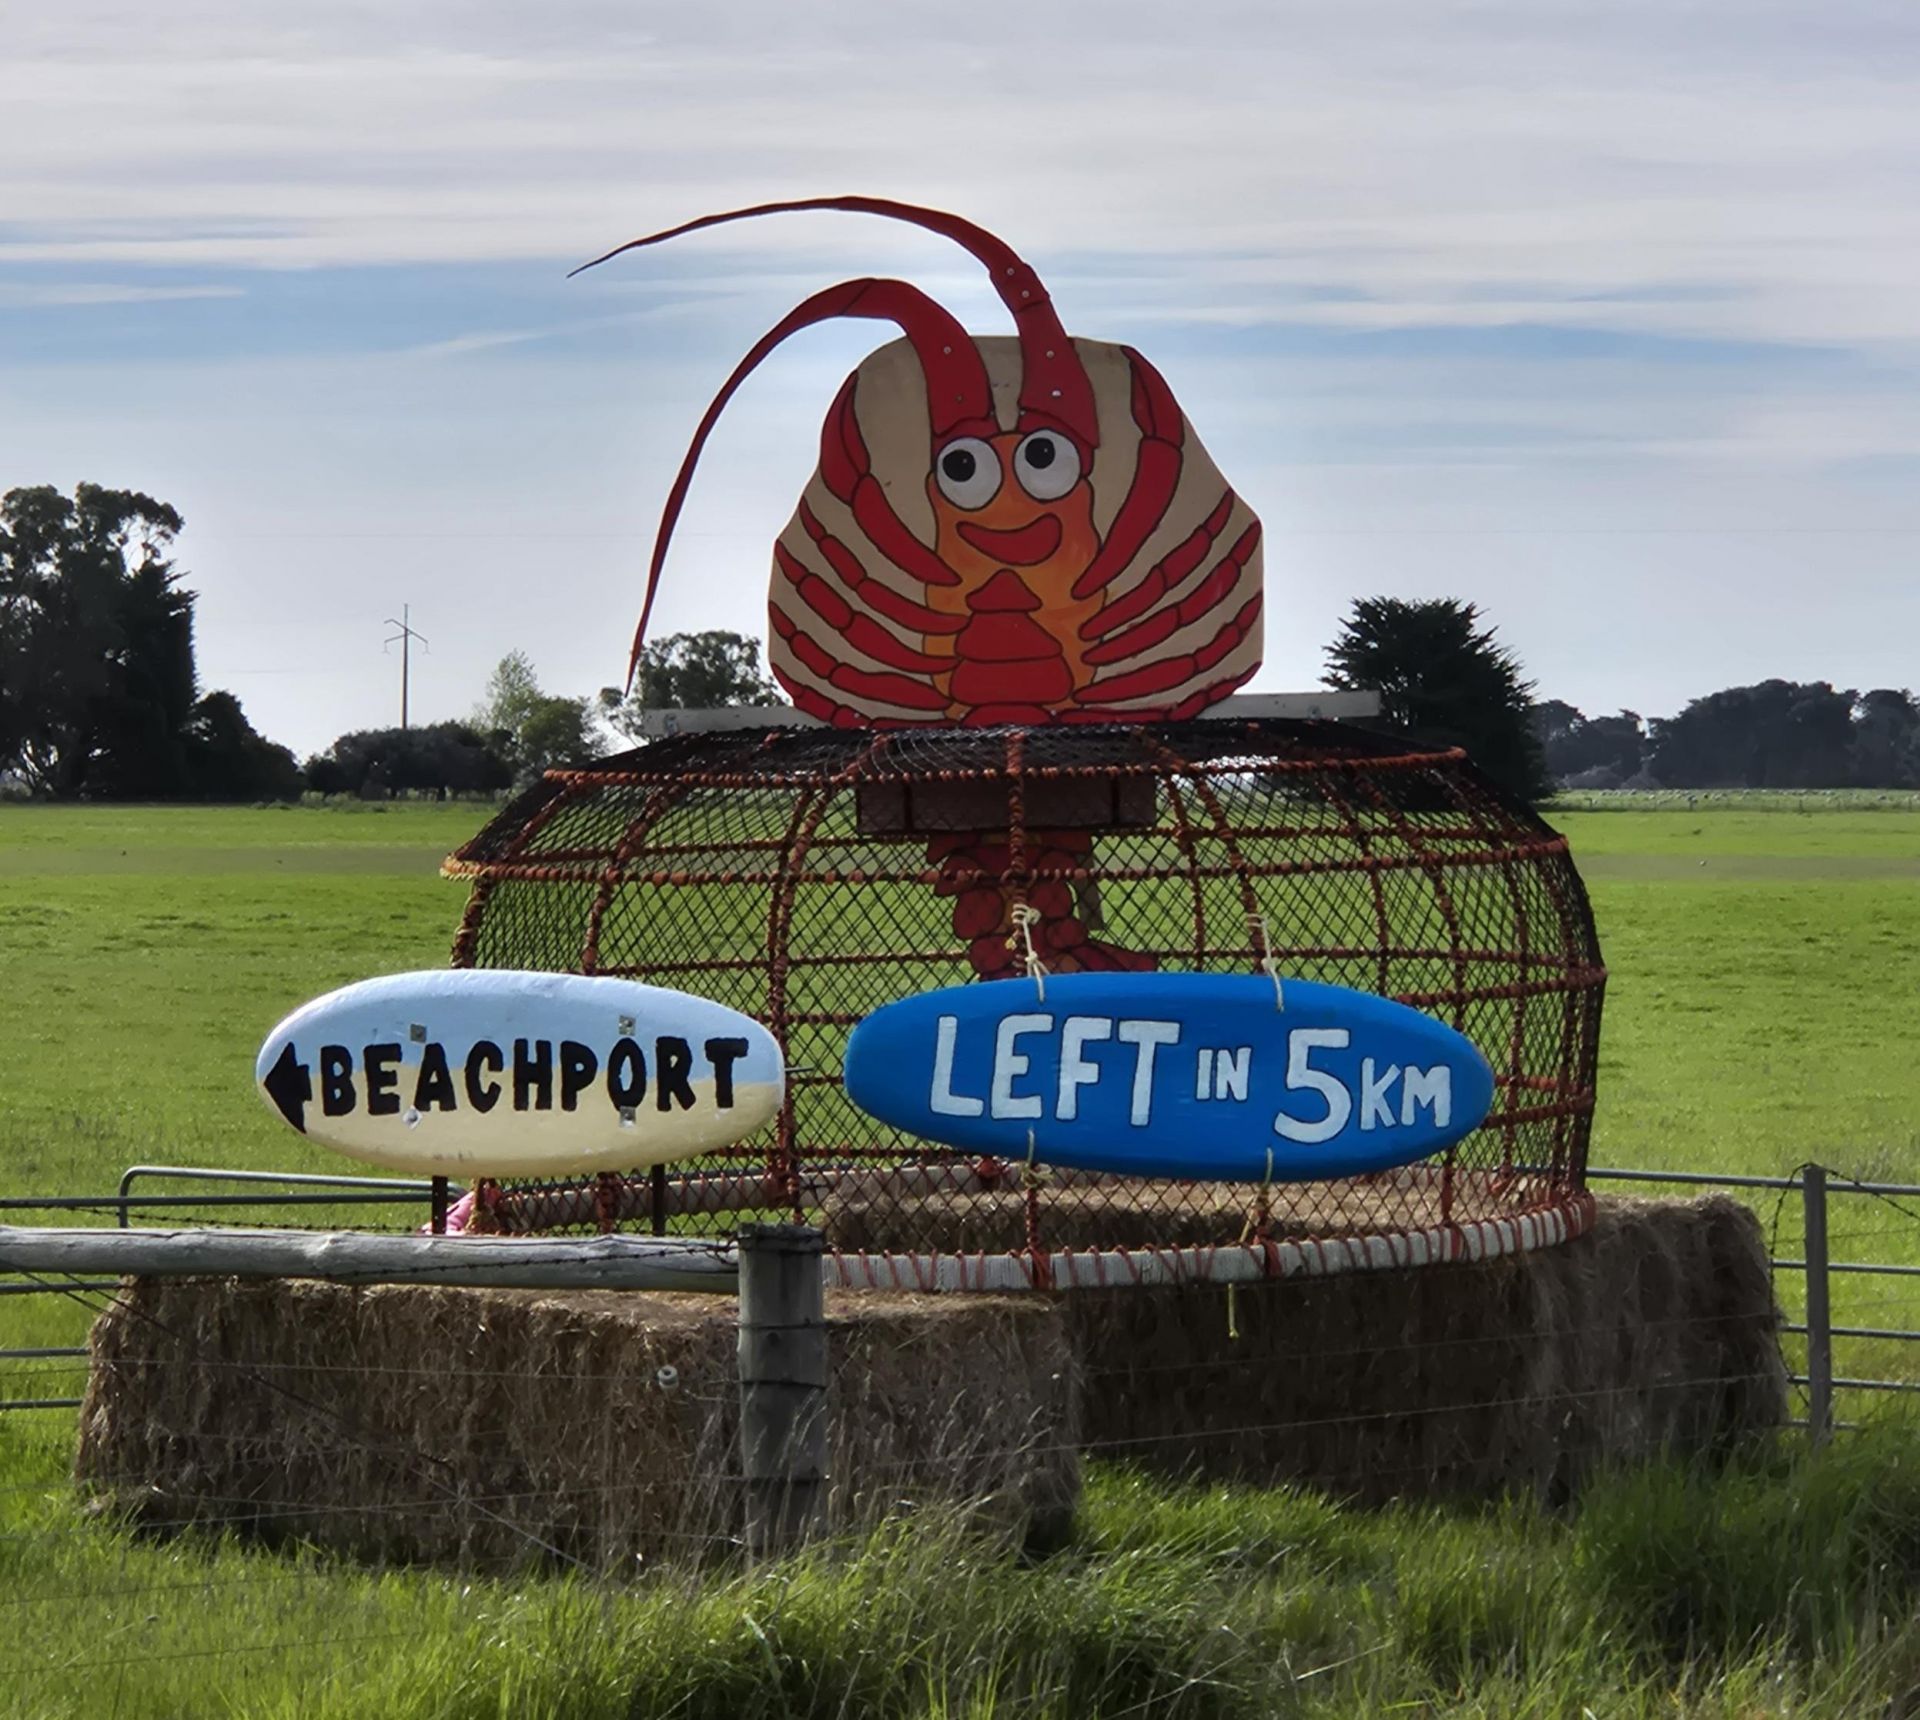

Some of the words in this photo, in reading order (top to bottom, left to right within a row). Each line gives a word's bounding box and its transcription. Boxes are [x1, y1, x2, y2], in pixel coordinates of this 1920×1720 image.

[320, 1036, 749, 1117] BEACHPORT
[929, 1014, 1181, 1128] LEFT
[1195, 1046, 1252, 1104] IN
